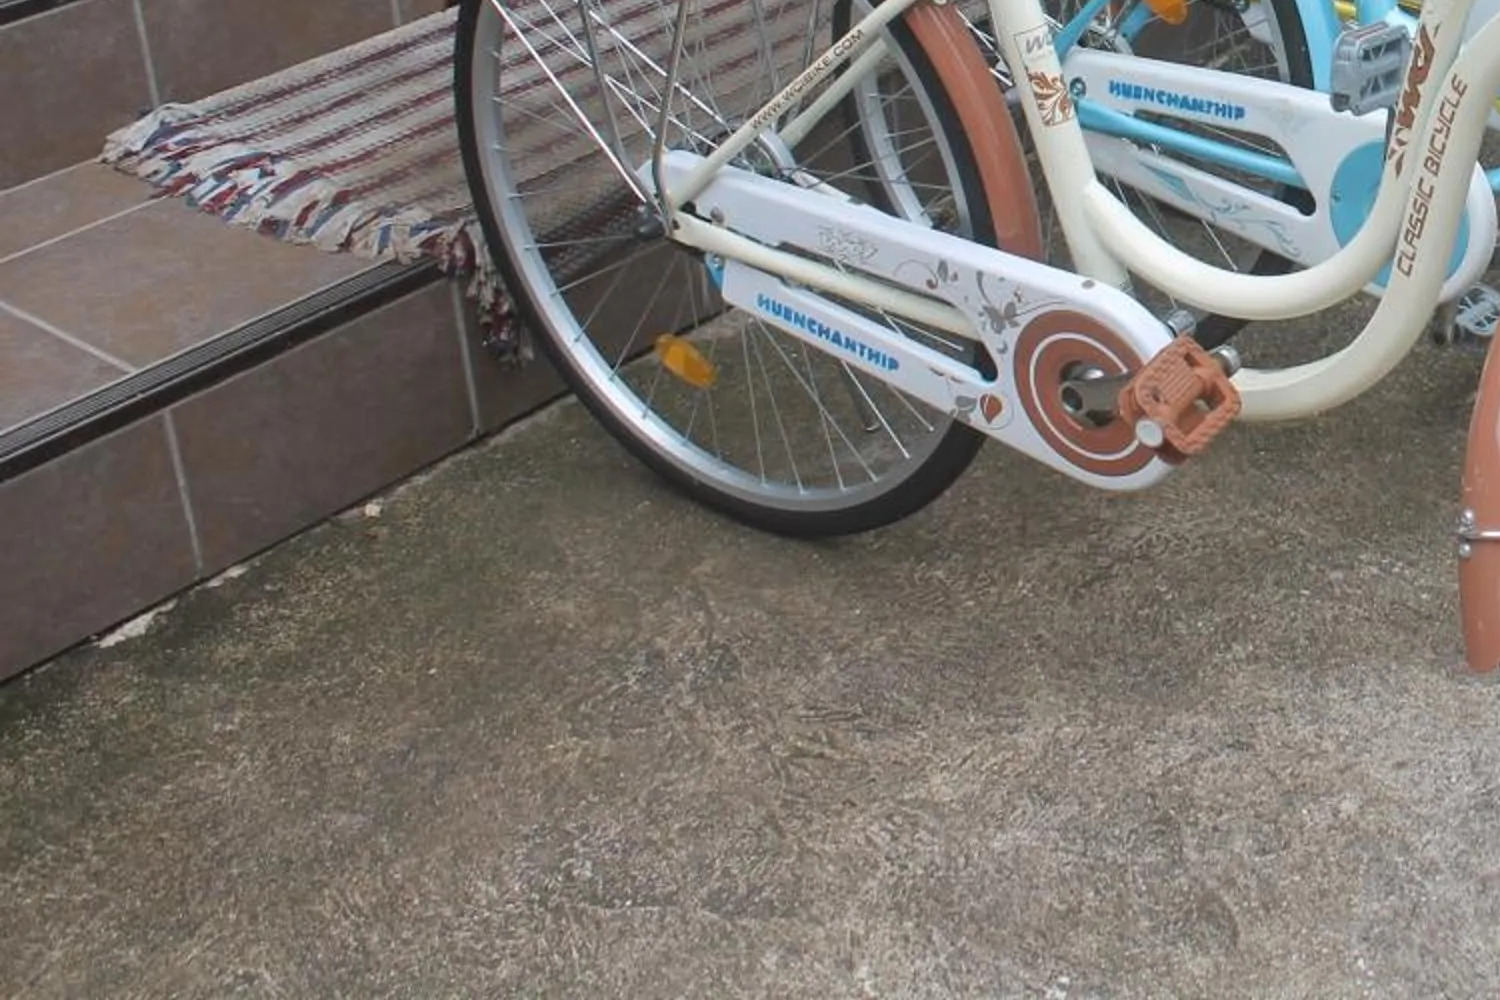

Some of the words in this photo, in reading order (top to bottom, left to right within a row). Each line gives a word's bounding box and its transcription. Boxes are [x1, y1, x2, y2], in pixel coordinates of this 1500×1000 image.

[1108, 79, 1246, 121] HUENCHANTHIP
[1397, 178, 1434, 277] CLASSIC
[1424, 73, 1468, 177] BICYCLE
[757, 293, 900, 371] HUENCHANTHIP
